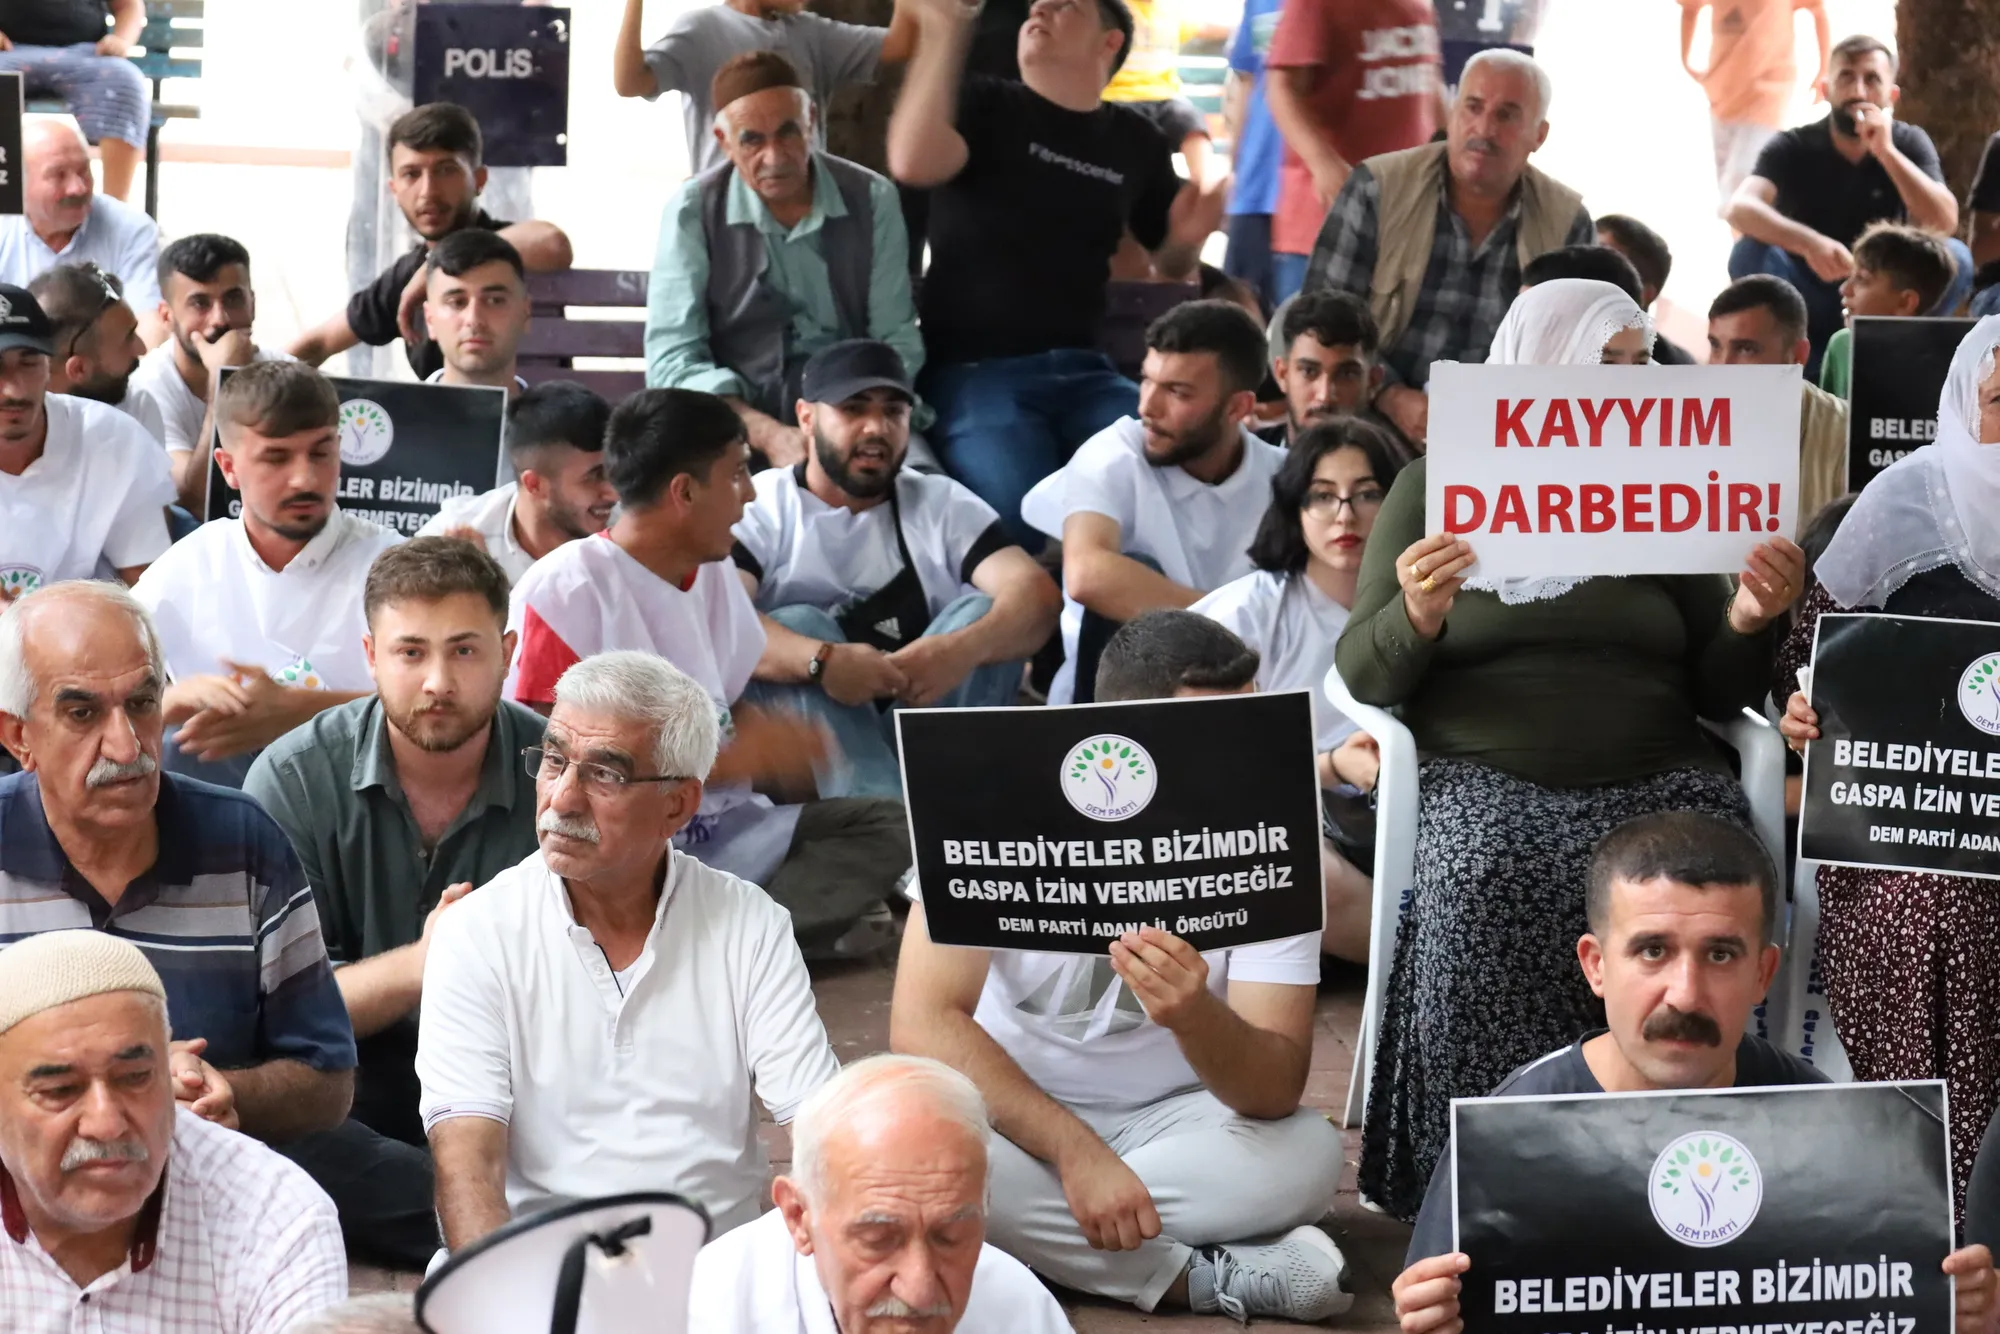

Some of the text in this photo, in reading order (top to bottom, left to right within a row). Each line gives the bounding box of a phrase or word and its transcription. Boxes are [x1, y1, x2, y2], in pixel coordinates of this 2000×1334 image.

[1495, 398, 1731, 447] KAYYIM
[1443, 470, 1781, 535] DARBEDİR!
[1834, 739, 2000, 779] BELEDİYELE
[1085, 799, 1138, 816] DEM PARTİ
[1830, 781, 1906, 809] GASPA
[1914, 782, 1962, 814] İZİN
[943, 821, 1290, 867] BELEDİYELER BİZİMDİR
[1869, 825, 1904, 843] DEM
[1908, 828, 1956, 848] PARTİ
[948, 863, 1293, 904] GASPA İZİN VERMEYECEĞİZ
[998, 916, 1035, 933] DEM
[1038, 918, 1087, 936] PARTİ
[1175, 908, 1249, 934] ÖRGÜTÜ
[1675, 1217, 1738, 1241] DEM PARTİ
[1494, 1254, 1914, 1314] BELEDİYELER BİZİMDİR
